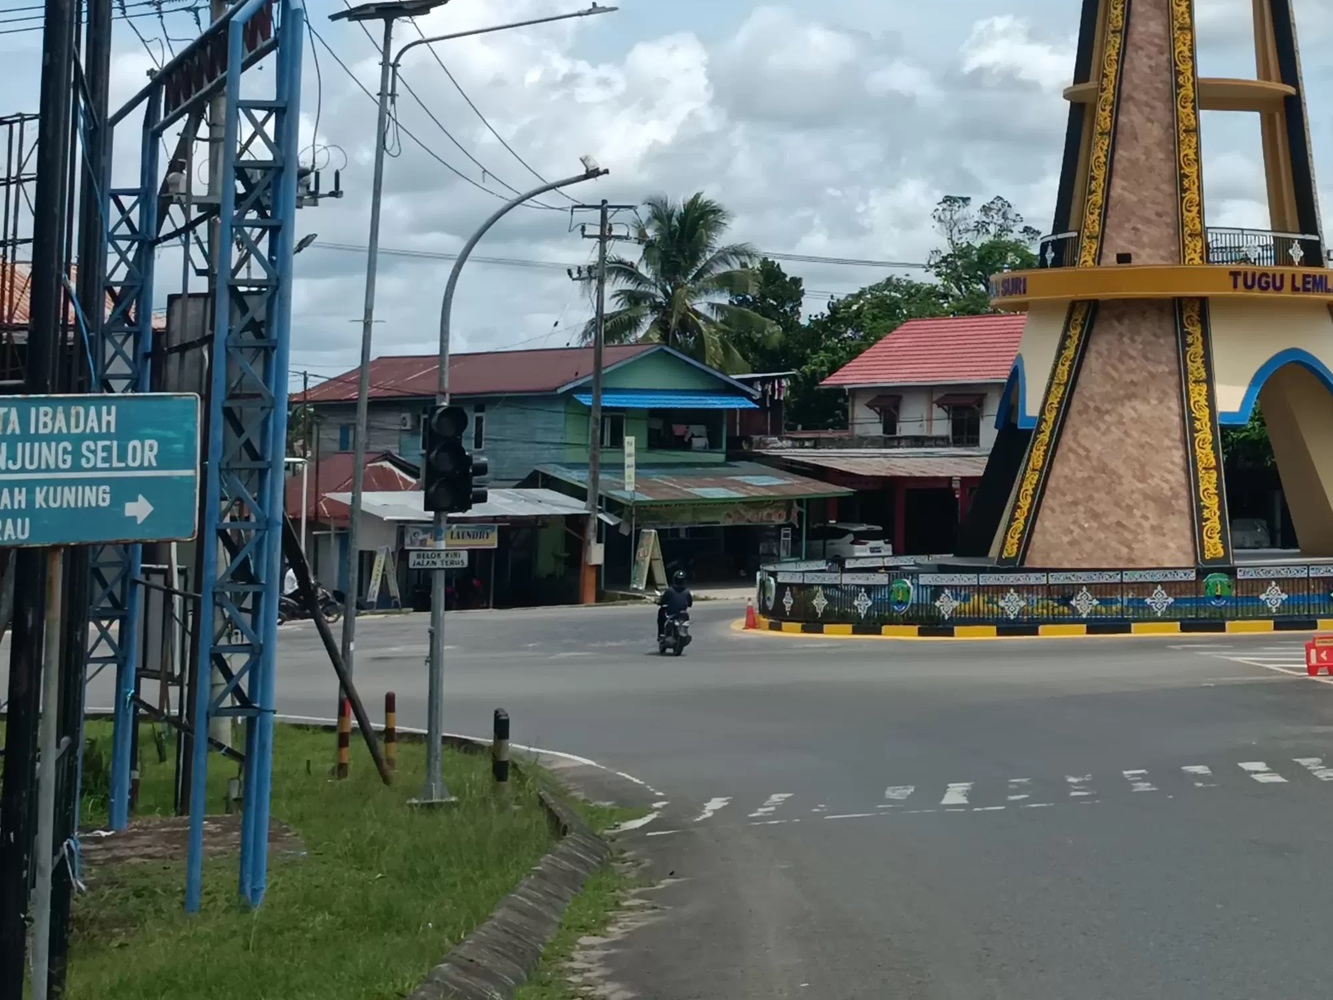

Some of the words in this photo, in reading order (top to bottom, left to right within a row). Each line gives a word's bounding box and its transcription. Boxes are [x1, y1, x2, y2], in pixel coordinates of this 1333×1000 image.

[1229, 270, 1285, 292] TUGU
[30, 405, 117, 434] IBADAH
[81, 439, 159, 468] SELOR
[0, 487, 26, 510] AH
[35, 485, 111, 509] KUNING
[0, 517, 30, 541] AU
[450, 530, 490, 540] LAUNDRY
[412, 559, 437, 567] JALAN
[440, 559, 465, 567] TERUS
[416, 551, 442, 560] BELOK
[445, 551, 462, 559] KIRI
